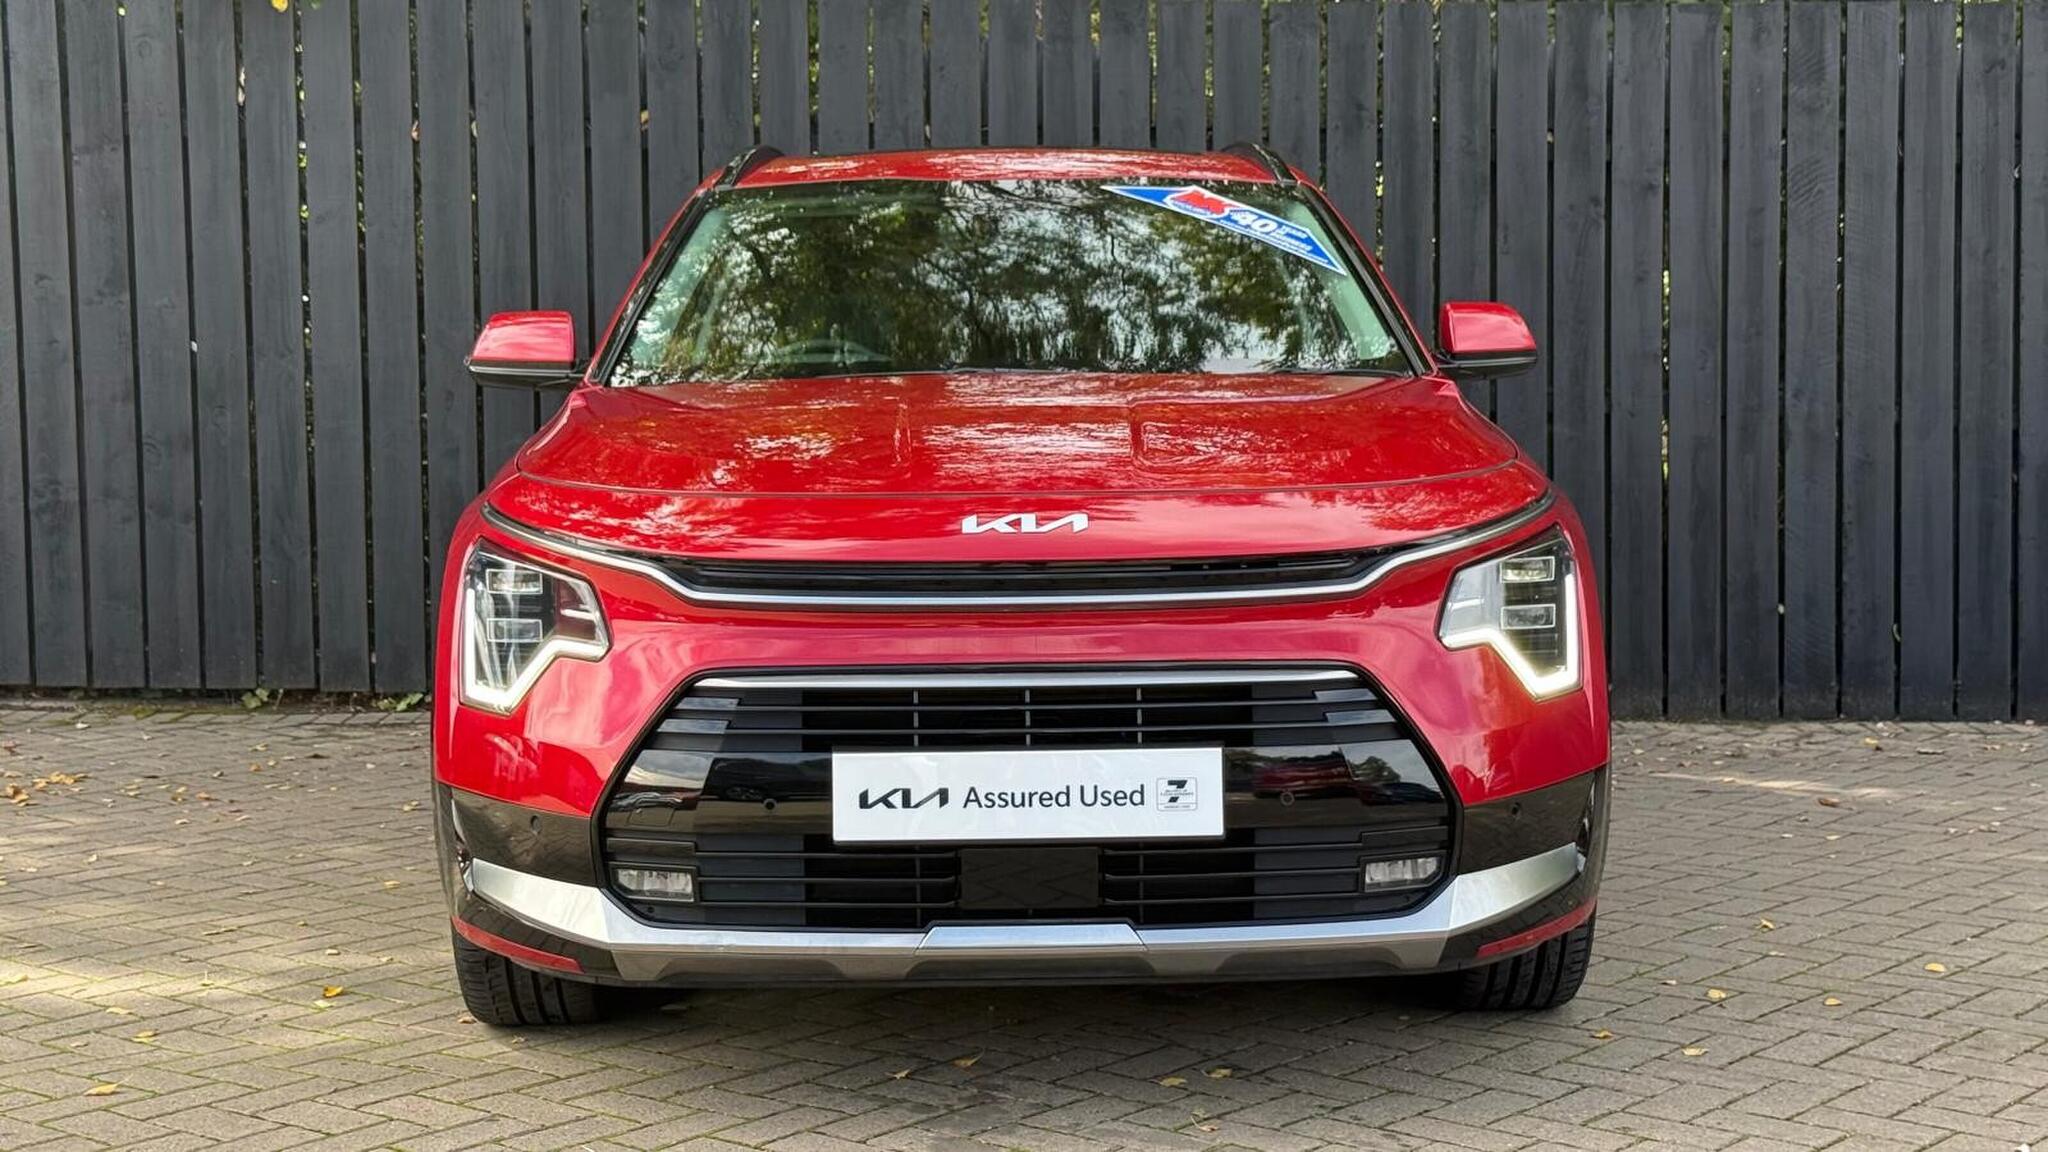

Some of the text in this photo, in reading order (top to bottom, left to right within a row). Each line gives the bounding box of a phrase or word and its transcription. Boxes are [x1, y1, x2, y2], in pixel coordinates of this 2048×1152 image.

[1232, 211, 1278, 233] 40
[962, 512, 1089, 534] KIA
[858, 783, 1145, 810] KIA Assured Used
